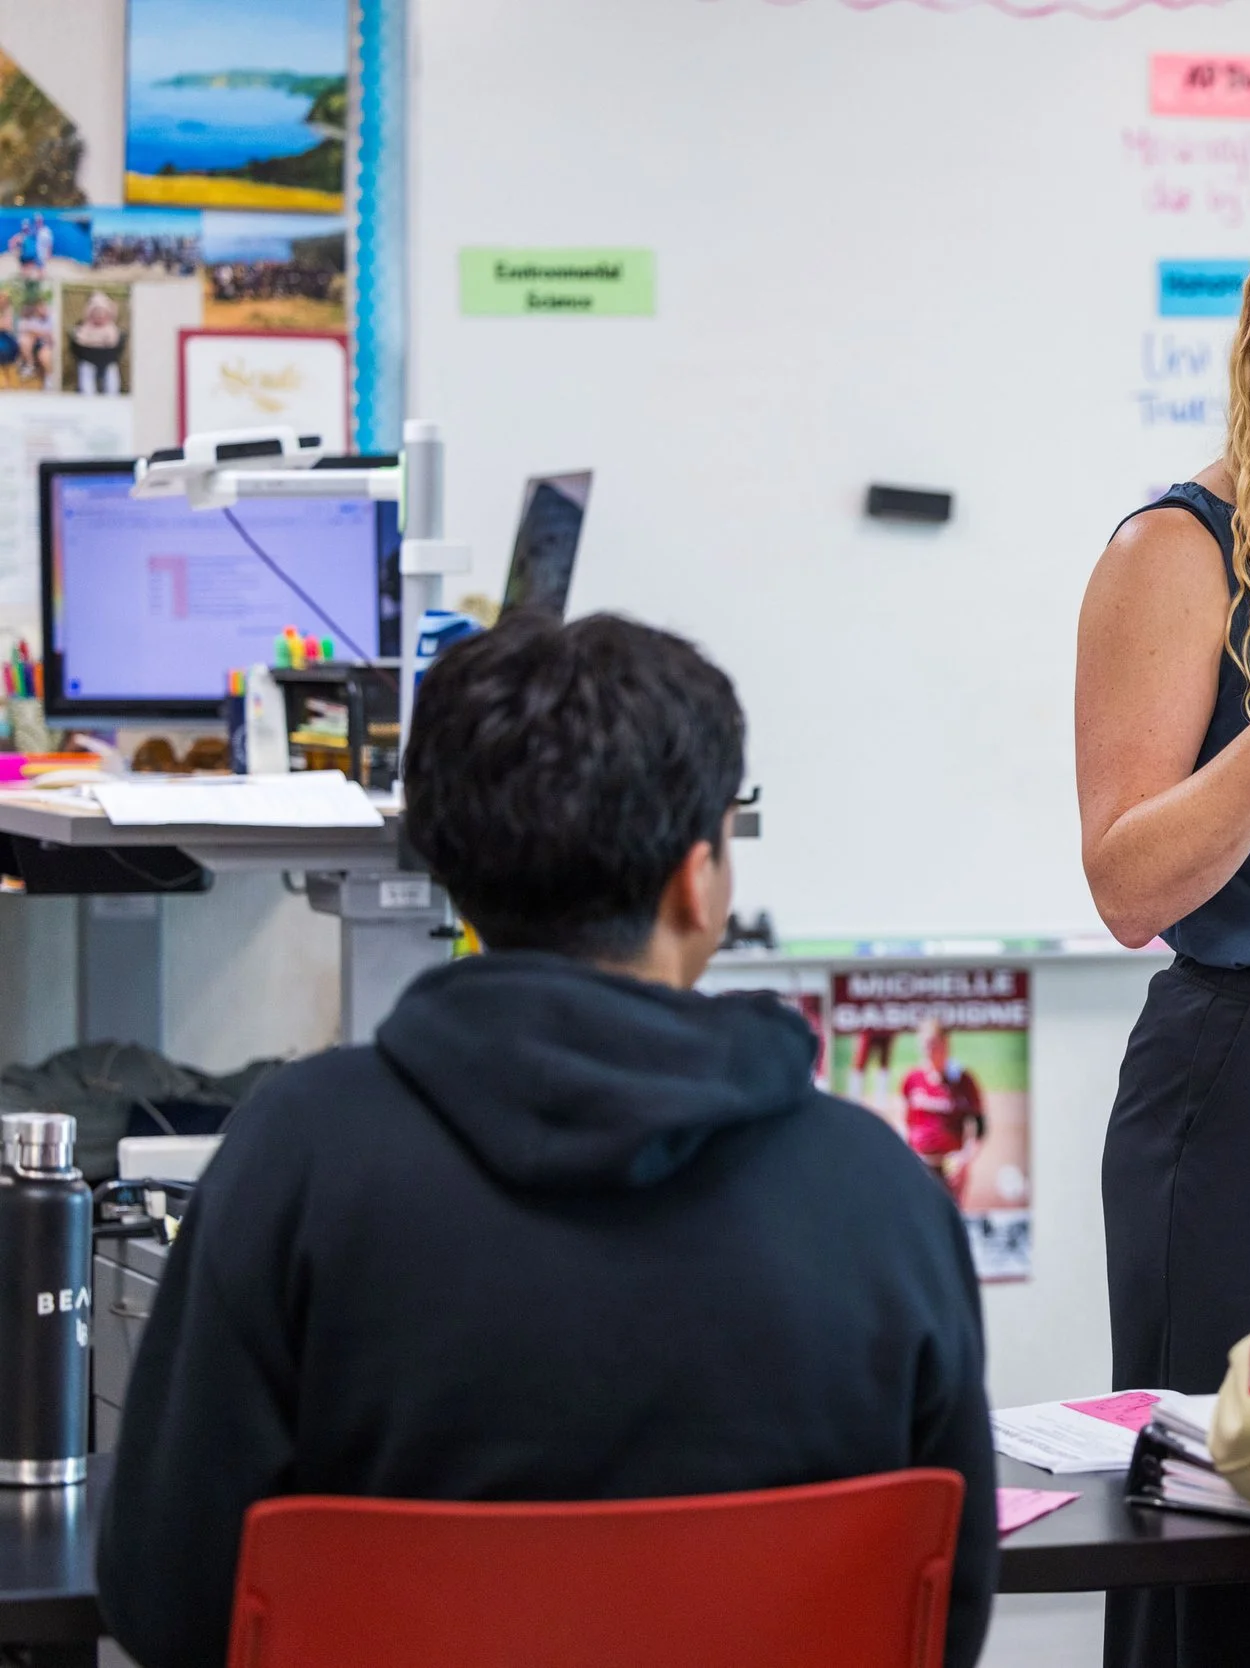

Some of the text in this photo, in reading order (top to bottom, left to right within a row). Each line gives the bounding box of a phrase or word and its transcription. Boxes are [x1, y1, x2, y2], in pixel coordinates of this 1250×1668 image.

[494, 259, 622, 282] Environmental
[526, 289, 592, 313] Science
[850, 970, 1014, 998] MICHELLE
